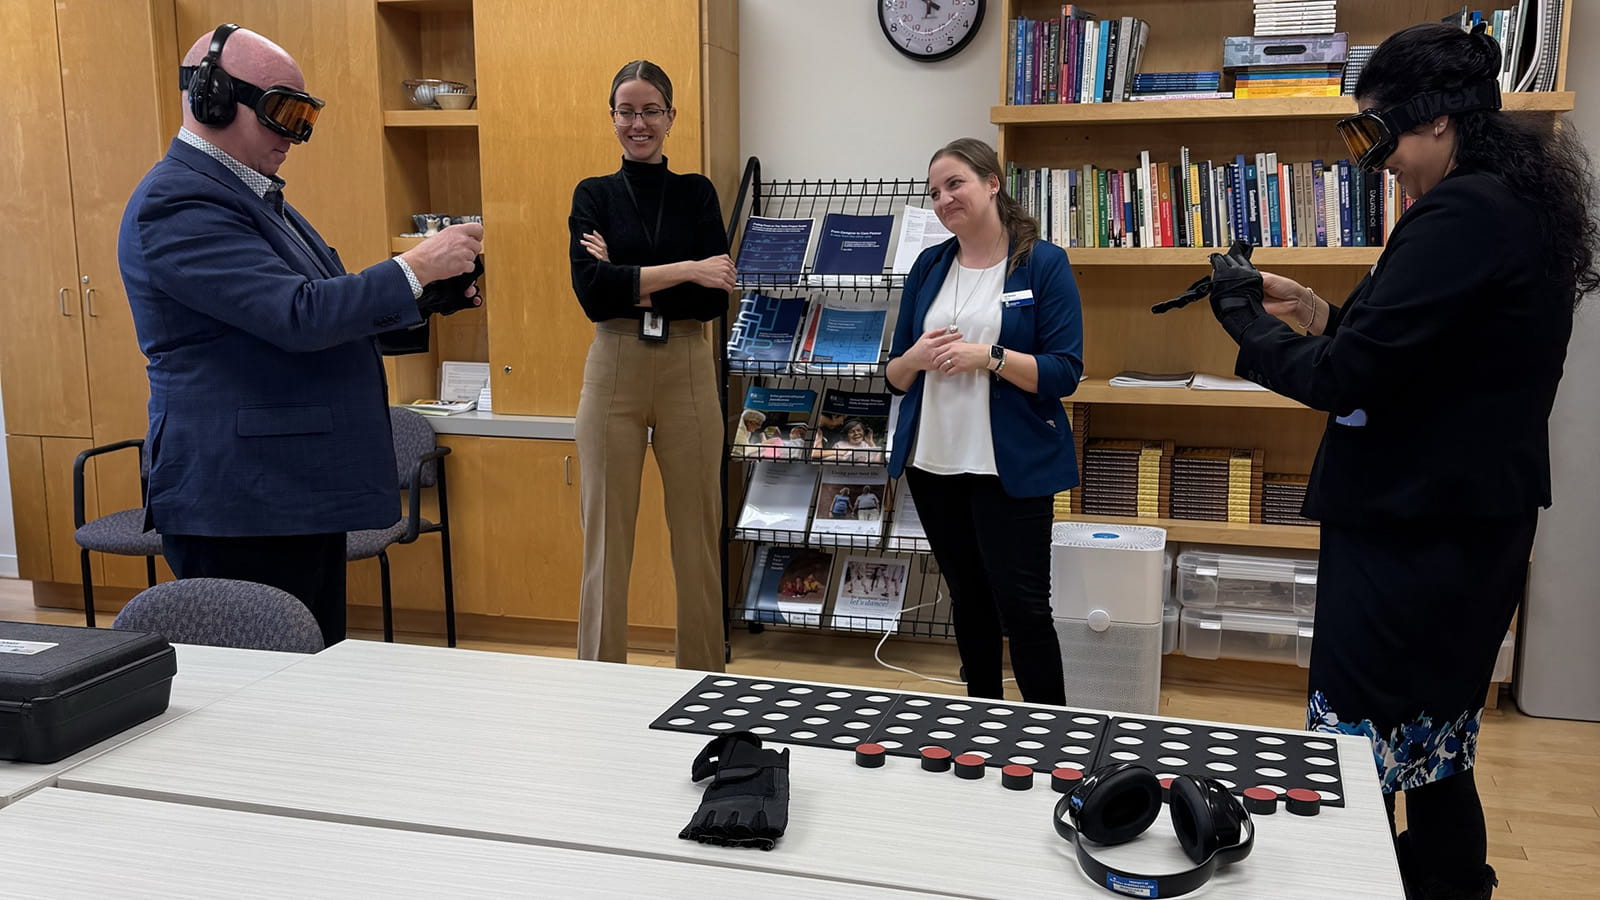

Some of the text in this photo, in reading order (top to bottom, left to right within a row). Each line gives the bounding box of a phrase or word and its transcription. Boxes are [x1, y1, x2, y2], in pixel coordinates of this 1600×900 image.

[890, 23, 897, 32] 8
[963, 20, 969, 28] 4
[905, 38, 912, 48] 7
[946, 36, 954, 46] 5
[926, 43, 933, 53] 6
